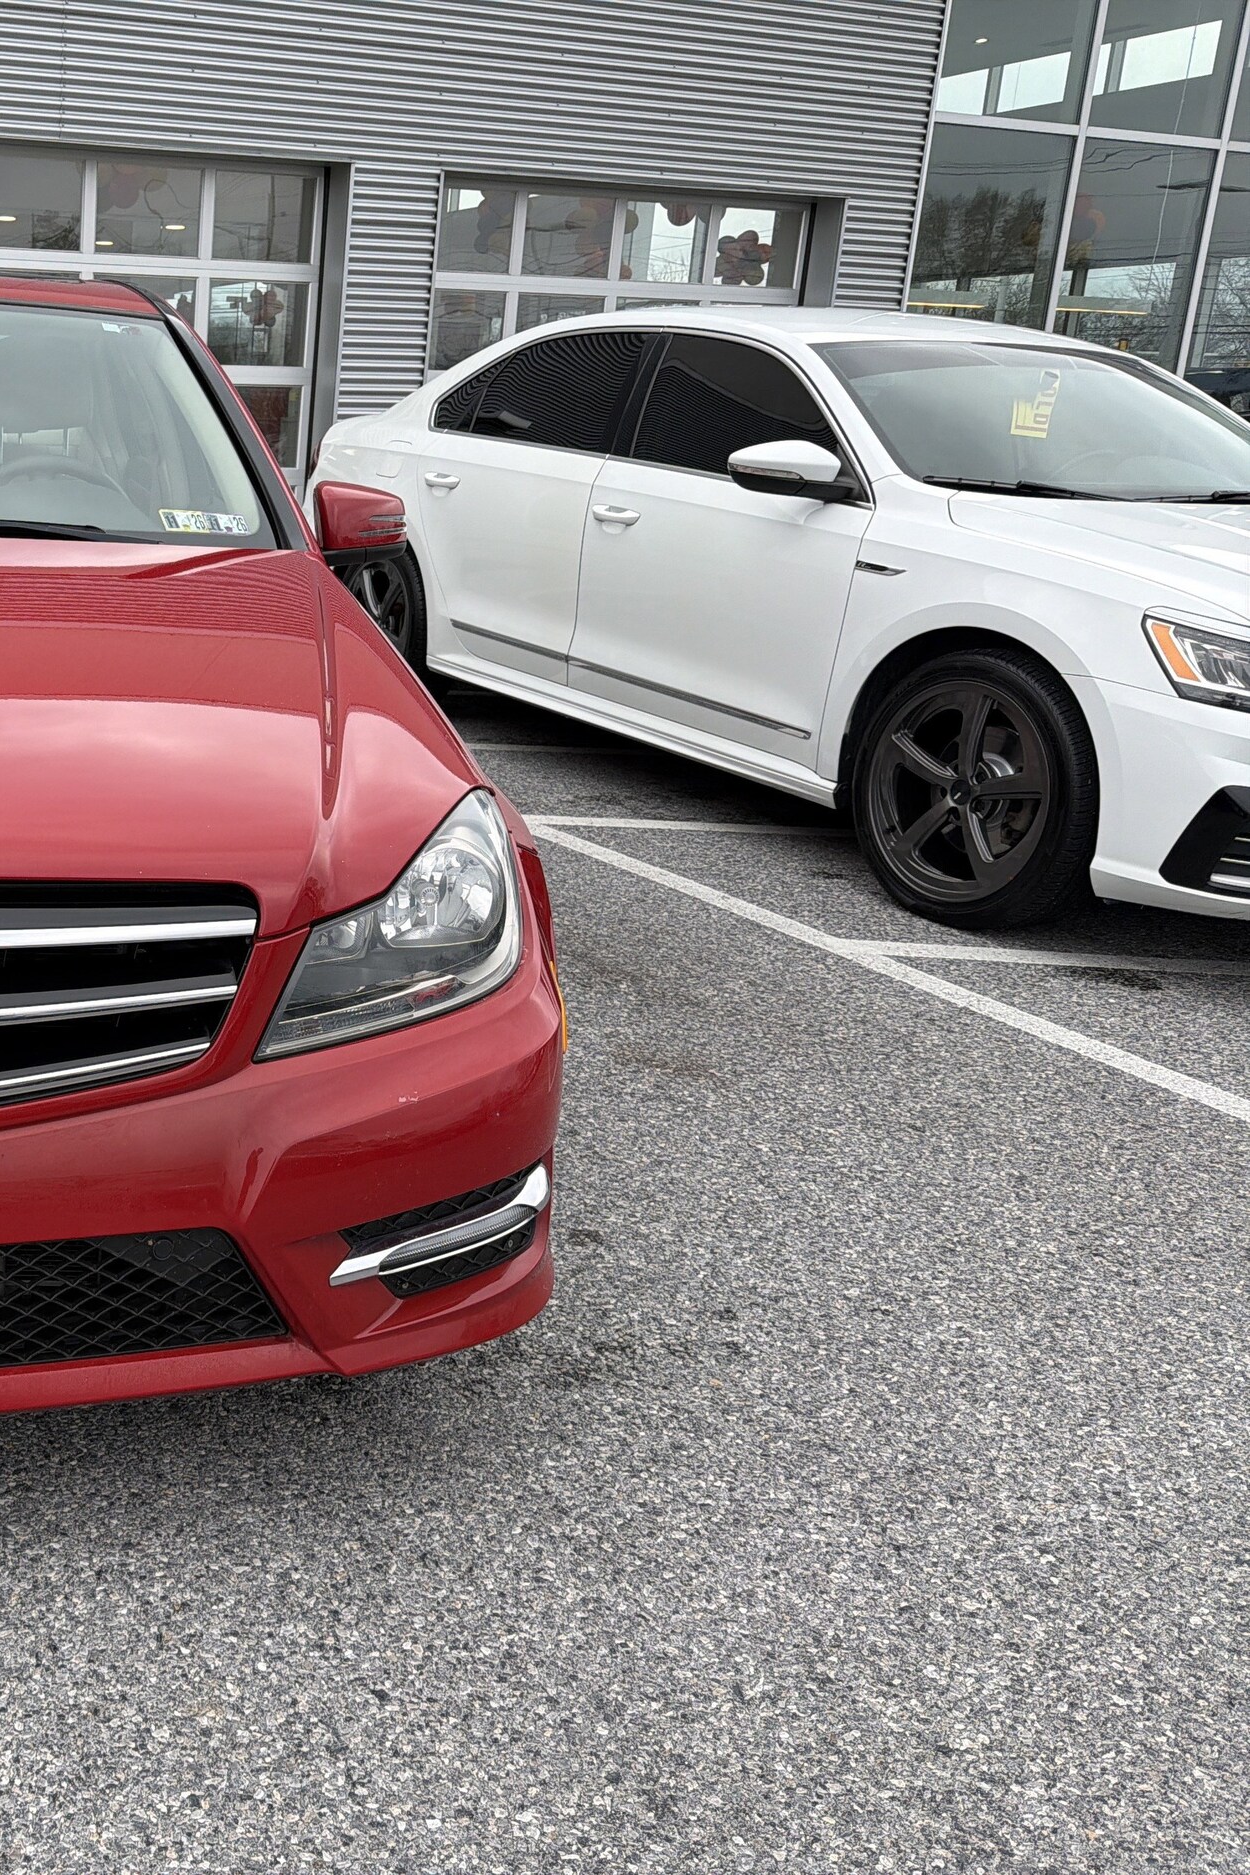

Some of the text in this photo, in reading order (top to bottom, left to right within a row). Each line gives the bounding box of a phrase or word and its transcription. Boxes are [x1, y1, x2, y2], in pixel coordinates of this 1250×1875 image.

[164, 514, 205, 530] 11 26
[233, 516, 248, 532] 26
